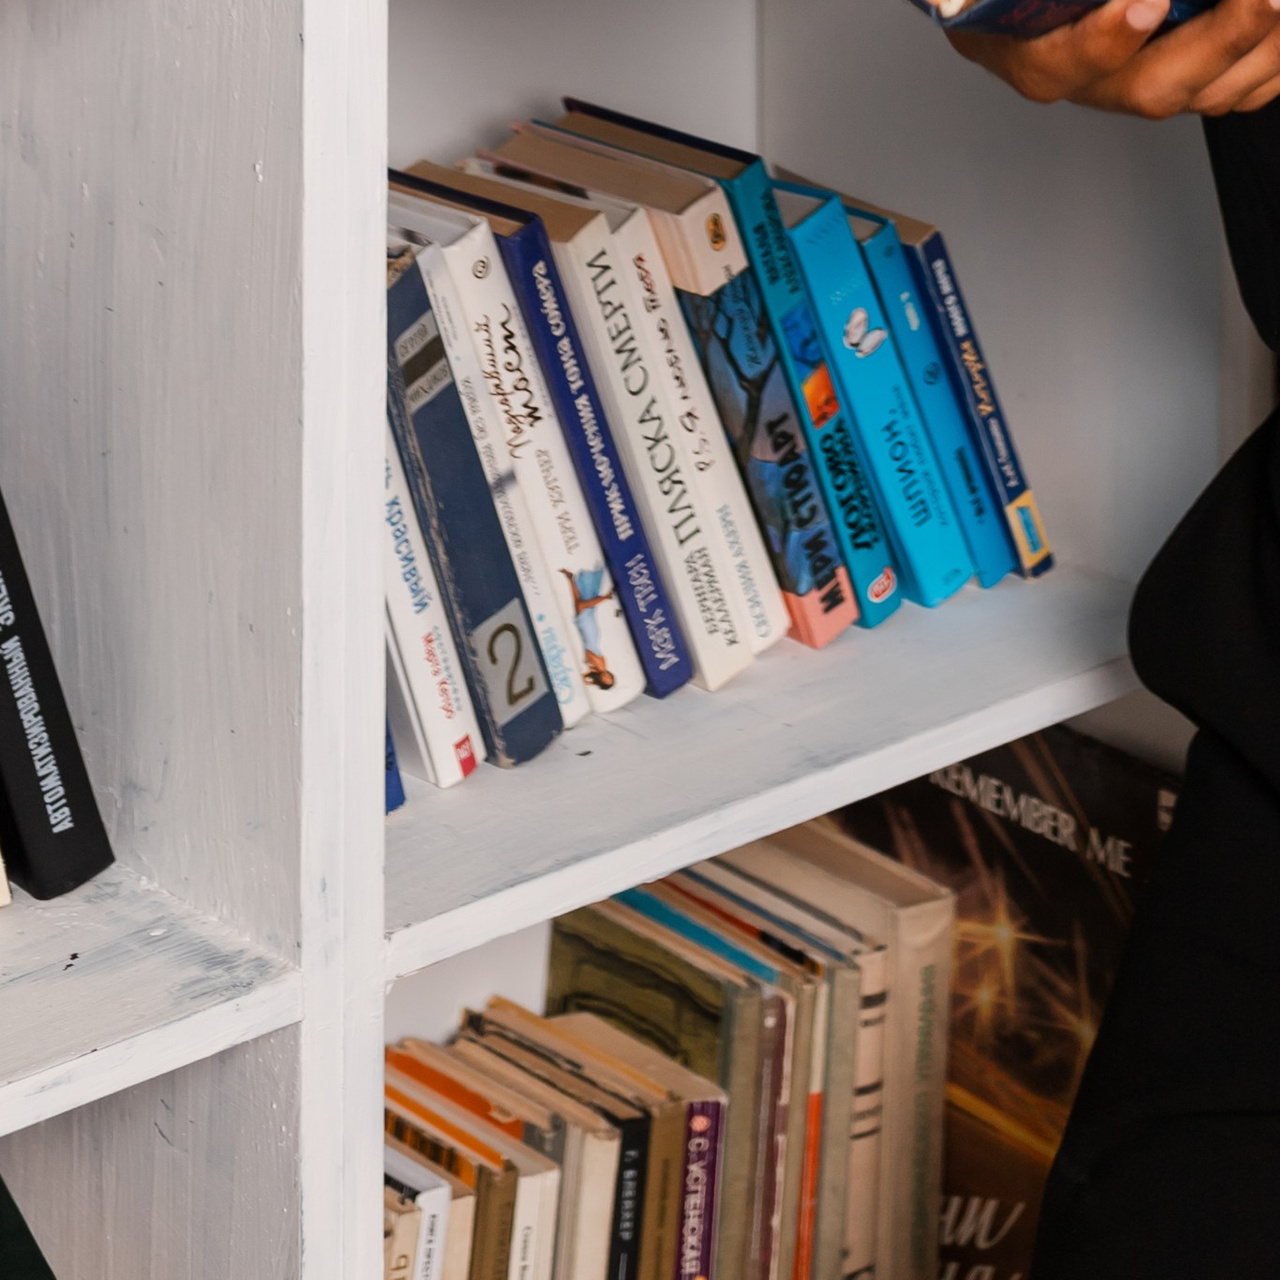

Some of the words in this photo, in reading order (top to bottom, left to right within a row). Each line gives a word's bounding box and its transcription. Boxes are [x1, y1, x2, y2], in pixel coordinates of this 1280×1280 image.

[586, 248, 652, 399] СМЕРТИ
[535, 447, 563, 509] ХЭТЧЕР
[637, 396, 704, 548] ПЛЯСКА
[765, 412, 821, 523] СТЮАРТ
[384, 492, 434, 616] красивый
[555, 509, 579, 556] ТЕРИ
[801, 528, 845, 615] МЕРИ
[684, 549, 721, 638] БЕРНГАРД
[696, 544, 741, 649] КЕЛЛЕРМАН
[487, 622, 536, 706] 2
[1085, 819, 1135, 880] ME
